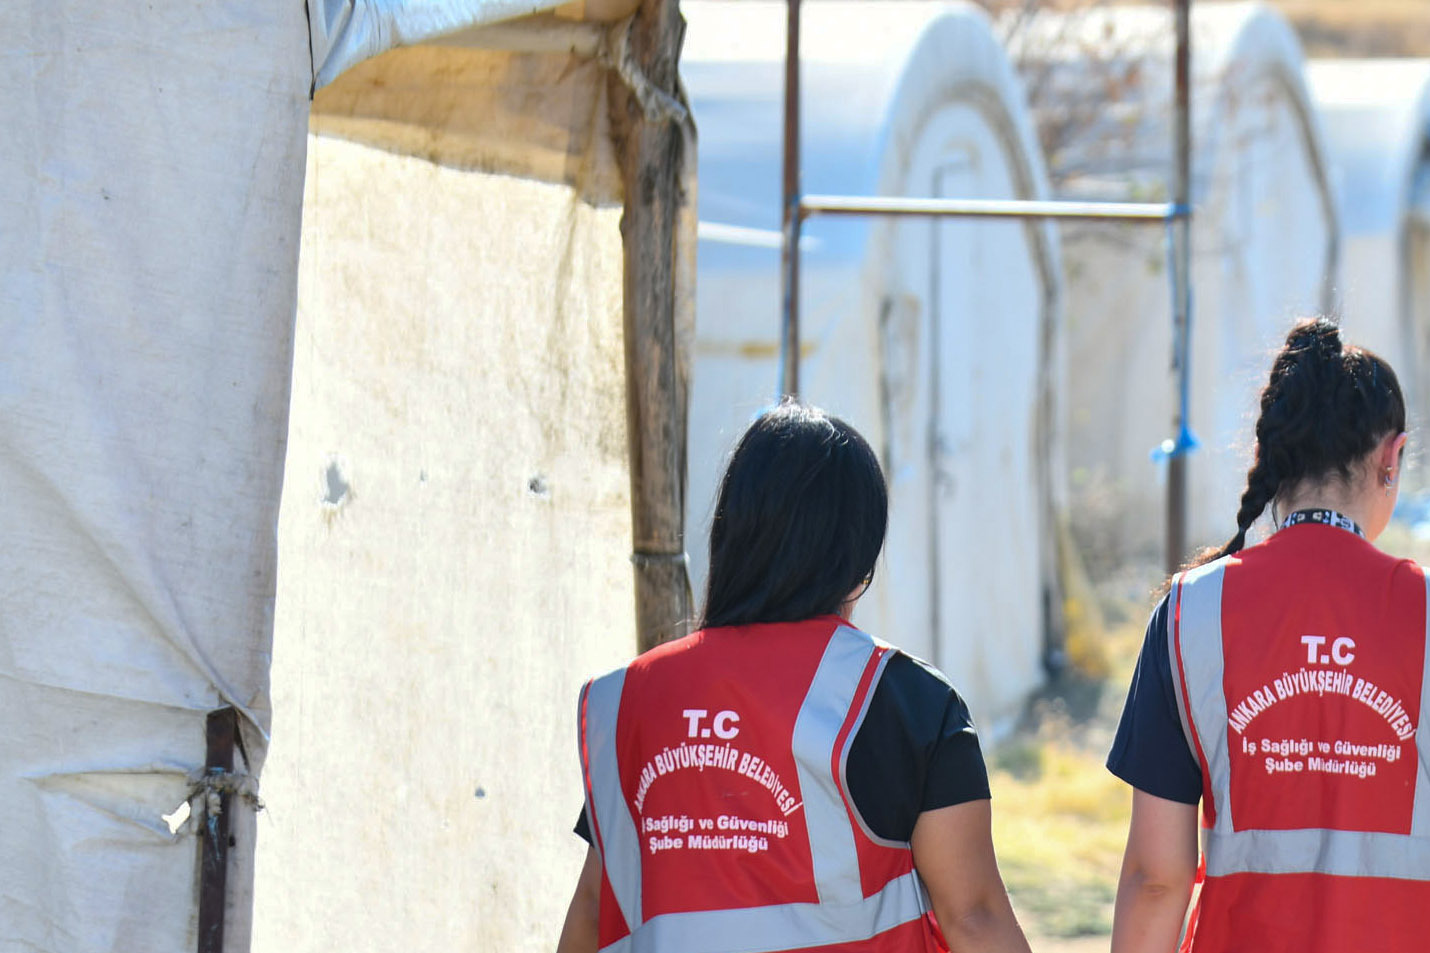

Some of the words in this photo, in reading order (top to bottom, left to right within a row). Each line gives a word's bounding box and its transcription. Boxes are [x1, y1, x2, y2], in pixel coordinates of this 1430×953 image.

[1300, 635, 1356, 665] T.C
[1228, 685, 1278, 735] ANKARA
[1274, 668, 1354, 700] BÜYÜKŞEHİR
[1352, 678, 1416, 741] BELEDİYESİ
[683, 709, 740, 739] T.C
[1242, 737, 1257, 756] İş
[1261, 738, 1313, 757] Sağlığı
[1318, 741, 1330, 753] ve
[1334, 740, 1401, 762] Güvenliği
[654, 742, 737, 776] BÜYÜKŞEHİR
[737, 753, 803, 816] BELEDİYESİ
[1265, 757, 1303, 774] Şube
[646, 815, 694, 834] Sağlığı
[699, 818, 714, 830] ve
[717, 815, 788, 838] Güvenliği
[649, 836, 683, 854] Şube
[688, 835, 768, 853] Müdürlüğü
